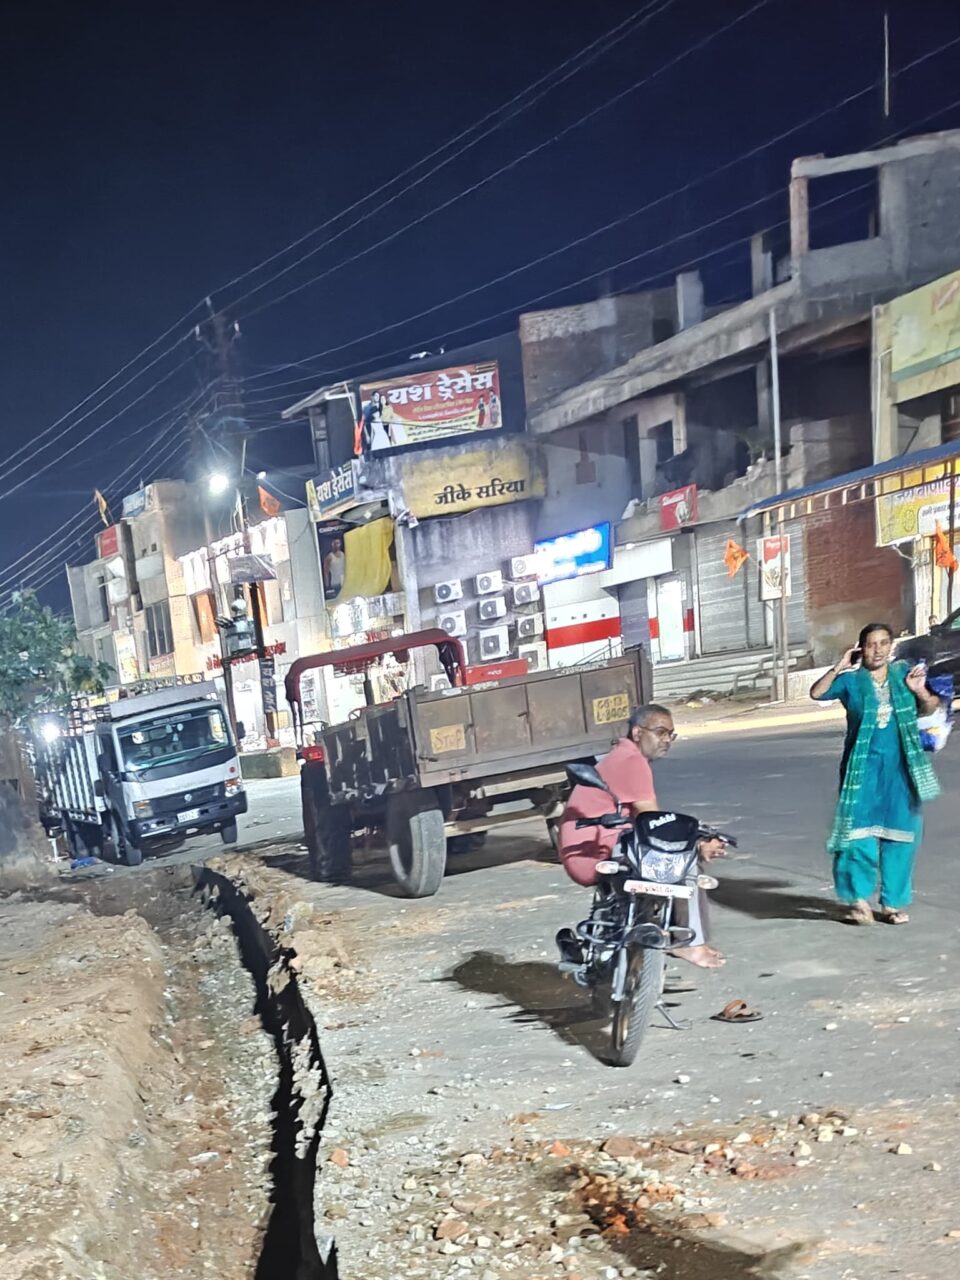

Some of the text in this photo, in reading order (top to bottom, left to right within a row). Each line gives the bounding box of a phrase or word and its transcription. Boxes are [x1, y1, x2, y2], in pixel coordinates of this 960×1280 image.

[387, 369, 495, 404] यश ड्रेसेस
[316, 467, 353, 502] यश ड्रेसेस
[434, 477, 526, 505] जीके सरिया
